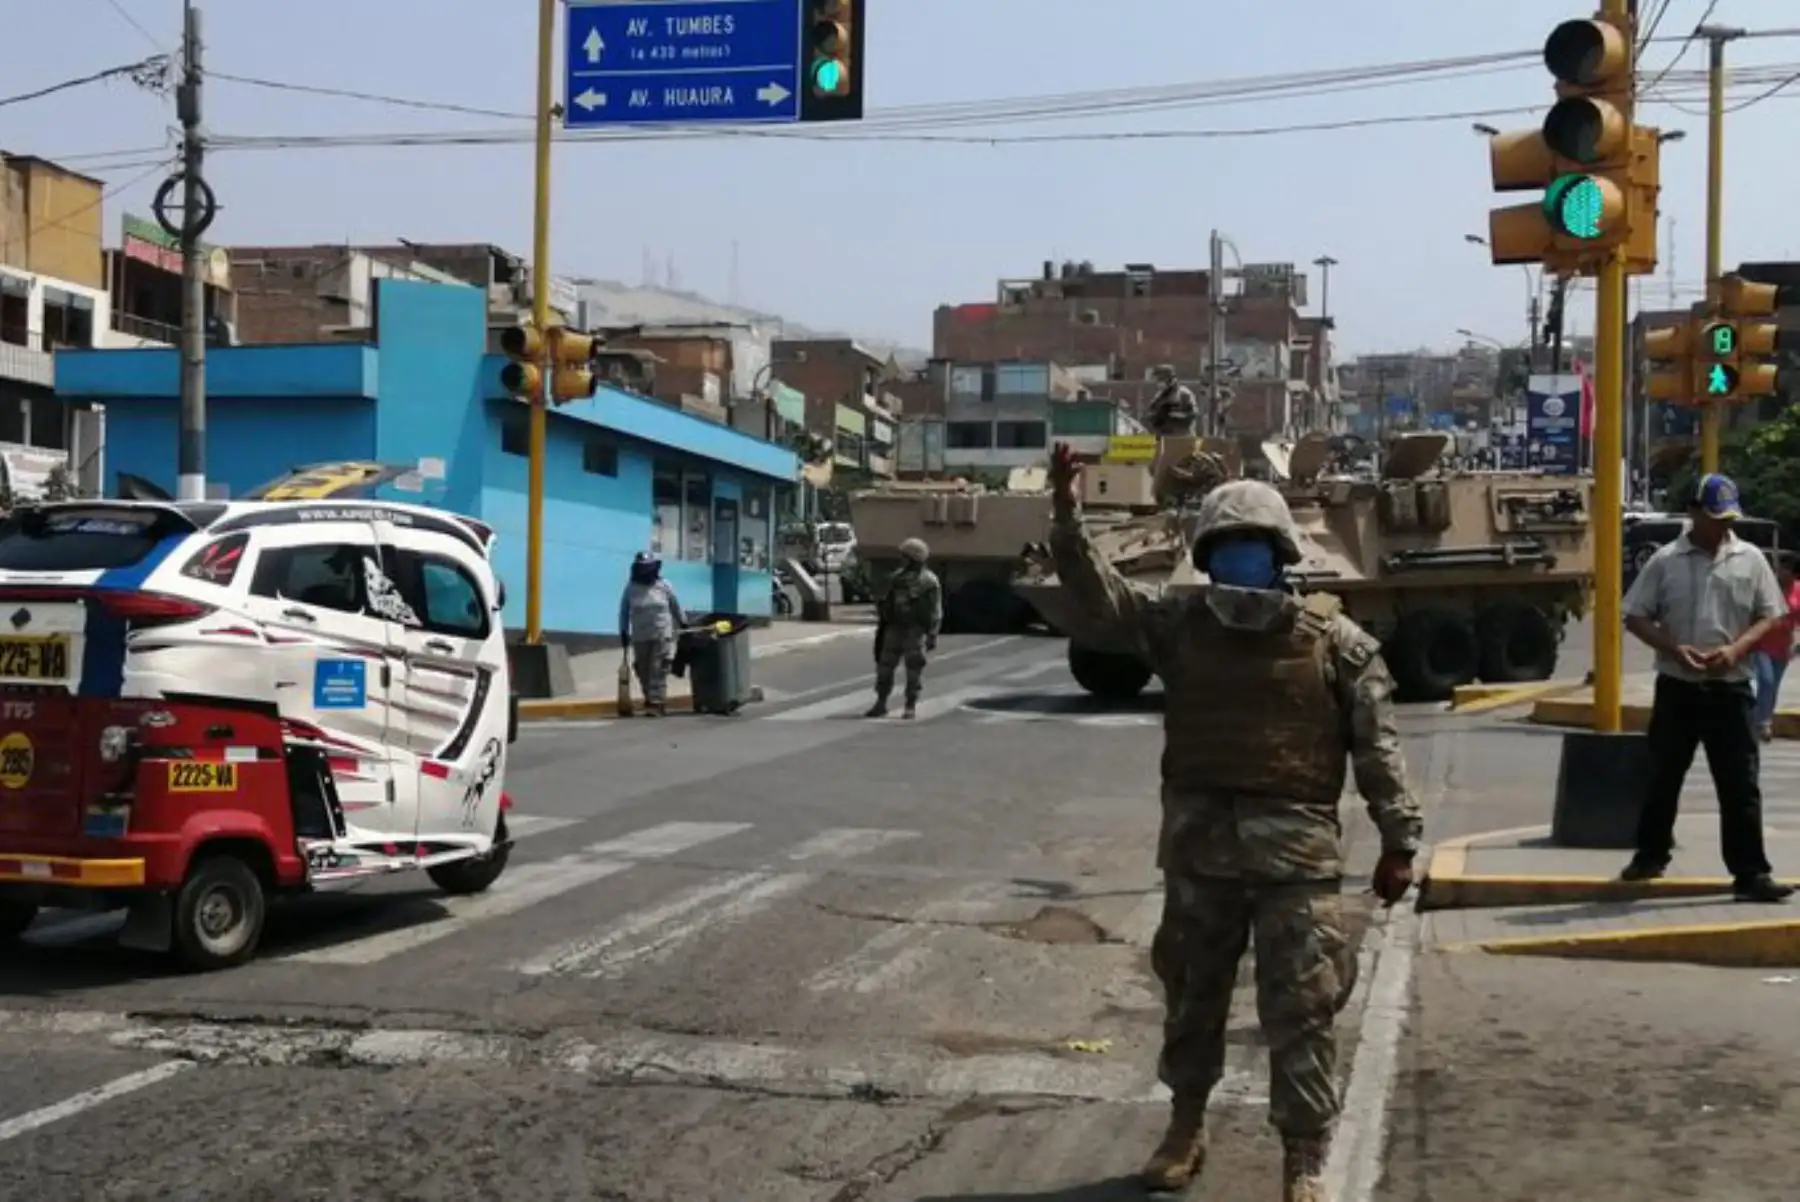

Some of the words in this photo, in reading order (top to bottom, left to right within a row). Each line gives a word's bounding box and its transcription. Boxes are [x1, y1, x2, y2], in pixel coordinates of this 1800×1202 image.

[626, 17, 653, 37] AV.
[665, 14, 735, 36] TUMBES
[628, 88, 653, 108] AV.
[664, 86, 734, 107] HUAURA
[172, 762, 234, 787] 2225-VA
